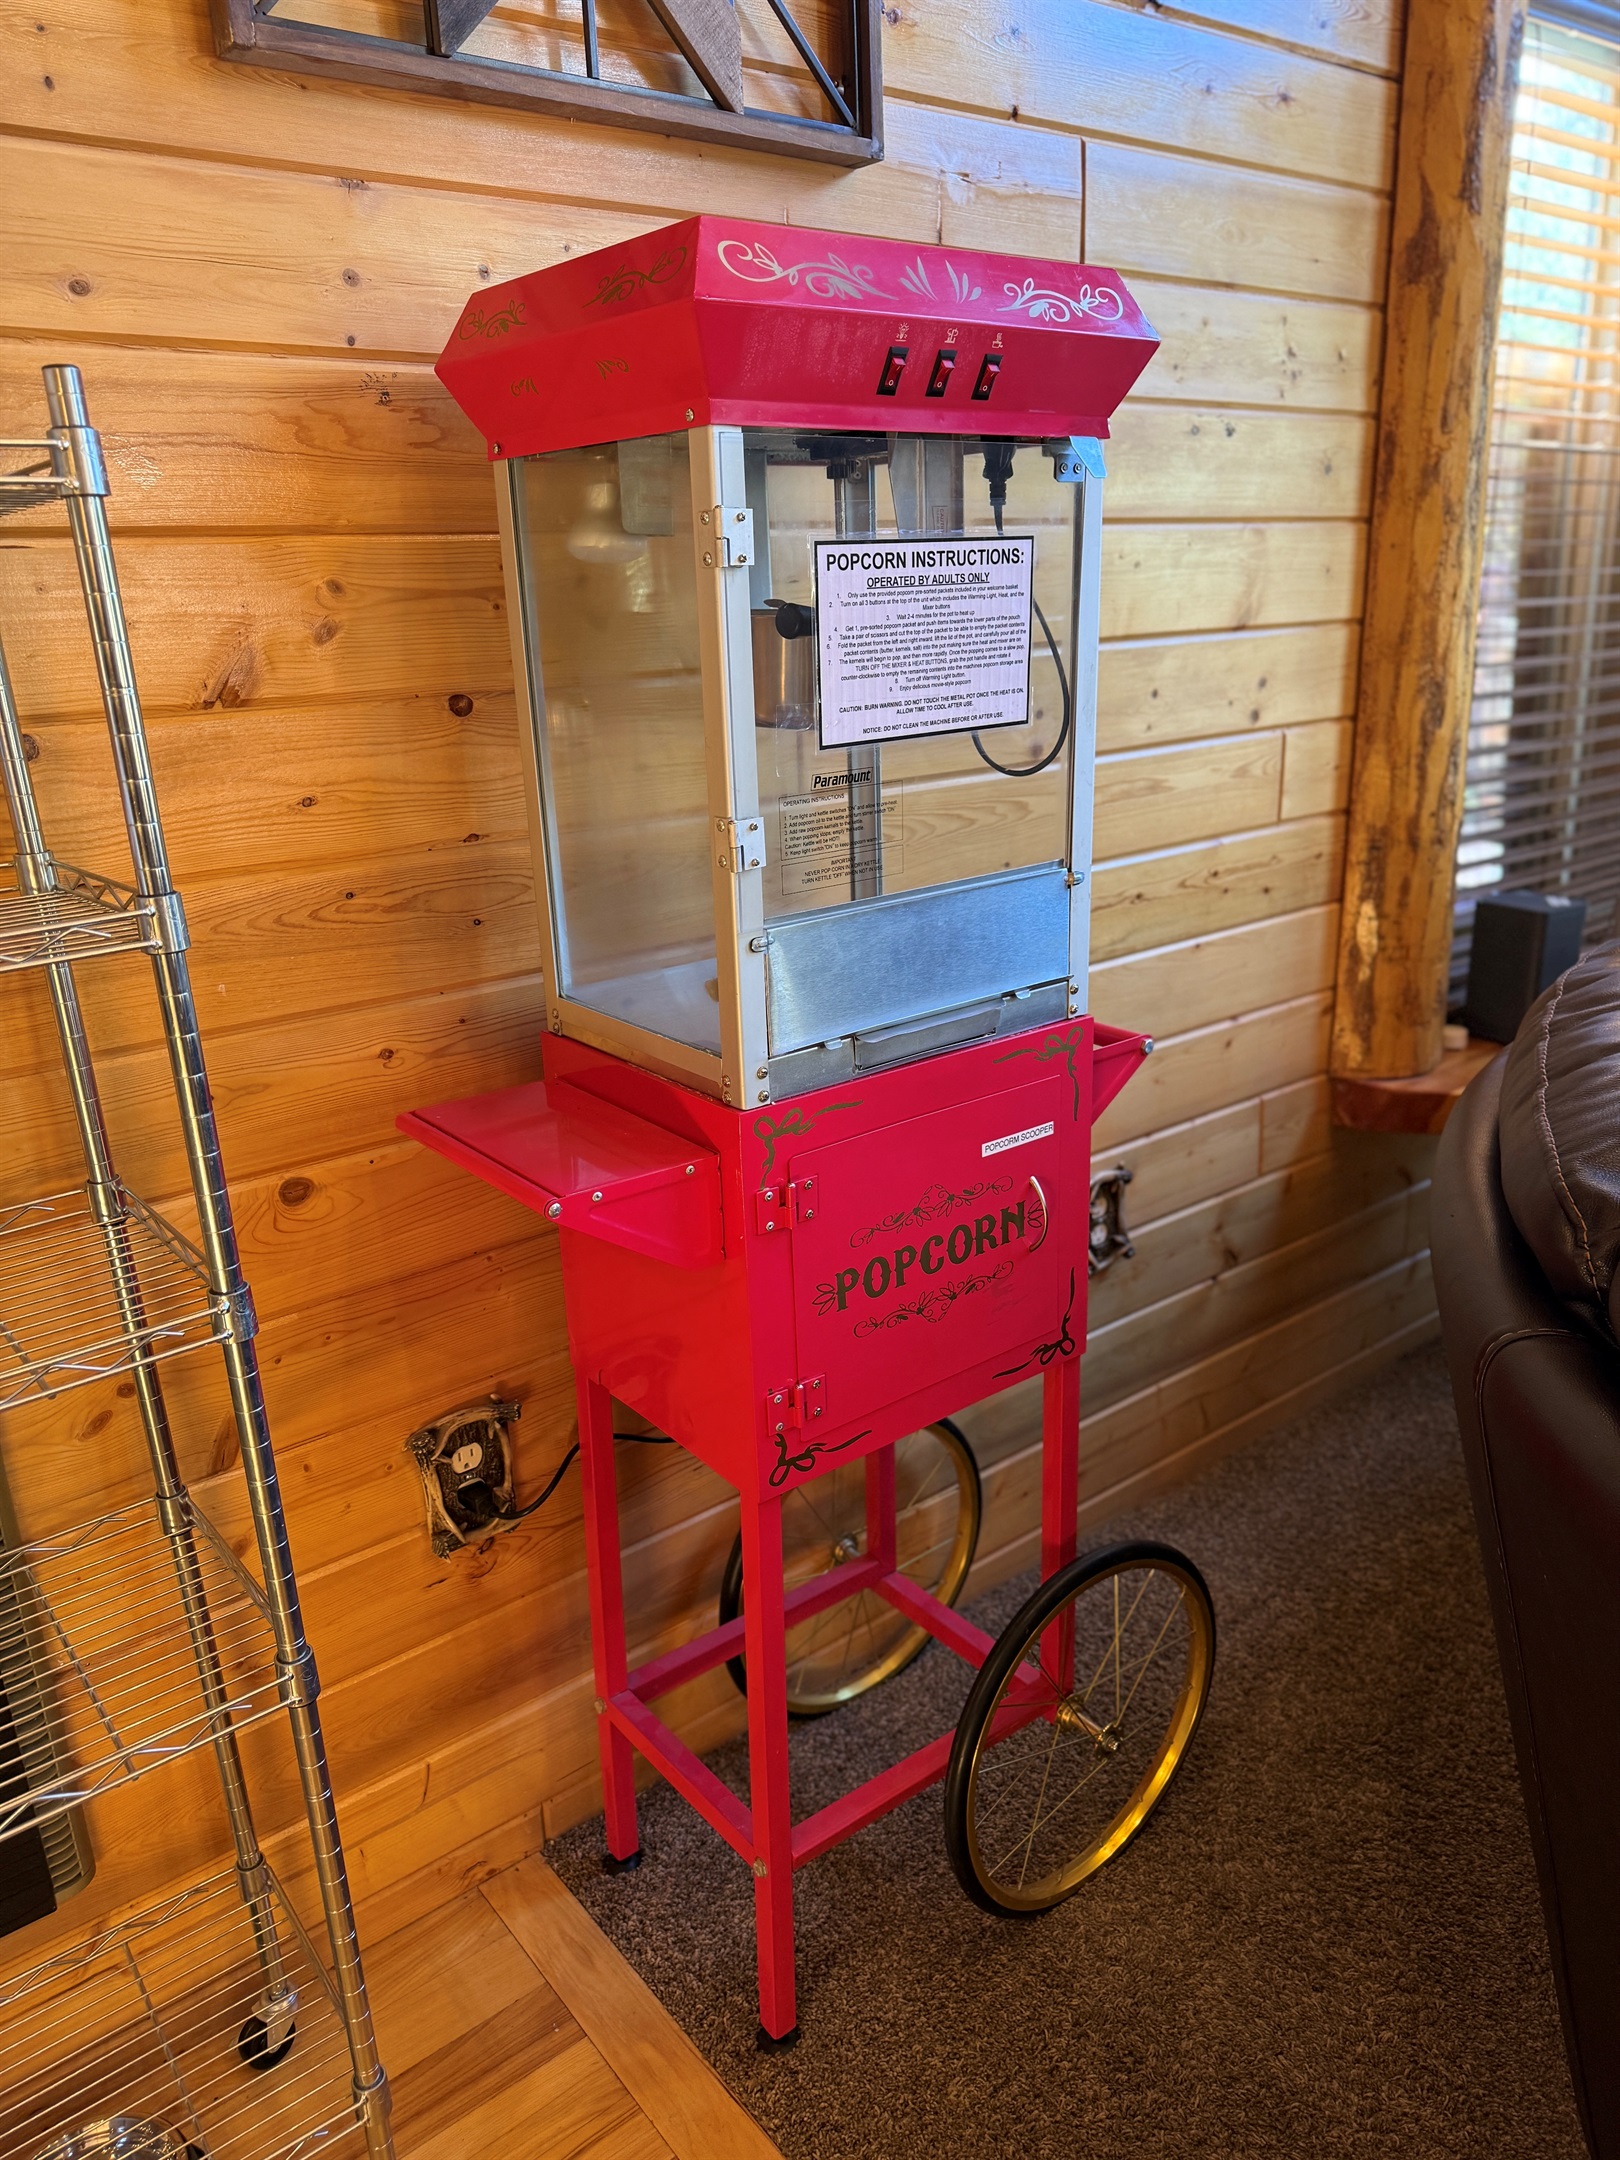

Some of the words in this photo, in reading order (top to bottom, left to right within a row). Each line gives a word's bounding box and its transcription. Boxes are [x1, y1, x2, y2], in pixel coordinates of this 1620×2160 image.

[826, 552, 906, 571] POPCORN
[912, 548, 1024, 568] INSTRUCTIONS:
[867, 575, 916, 588] OPERATED
[918, 575, 930, 585] BY
[932, 573, 966, 584] ADULTS
[968, 572, 989, 583] ONLY
[848, 592, 858, 600] Only
[877, 590, 896, 599] provided
[915, 588, 937, 596] pre-sorted
[937, 587, 954, 595] packets
[968, 593, 986, 601] Warming
[860, 624, 883, 633] pre-sorted
[902, 621, 916, 630] packet
[934, 627, 948, 635] packet
[899, 684, 912, 693] Enjoy
[931, 680, 954, 689] movie-style
[930, 718, 950, 726] MACHINE
[814, 770, 870, 788] Paramount
[783, 798, 810, 807] OPERATING
[811, 794, 844, 803] INSTRUCTIONS
[1020, 1124, 1053, 1142] SCOOPER
[834, 1200, 1026, 1312] POPCORN
